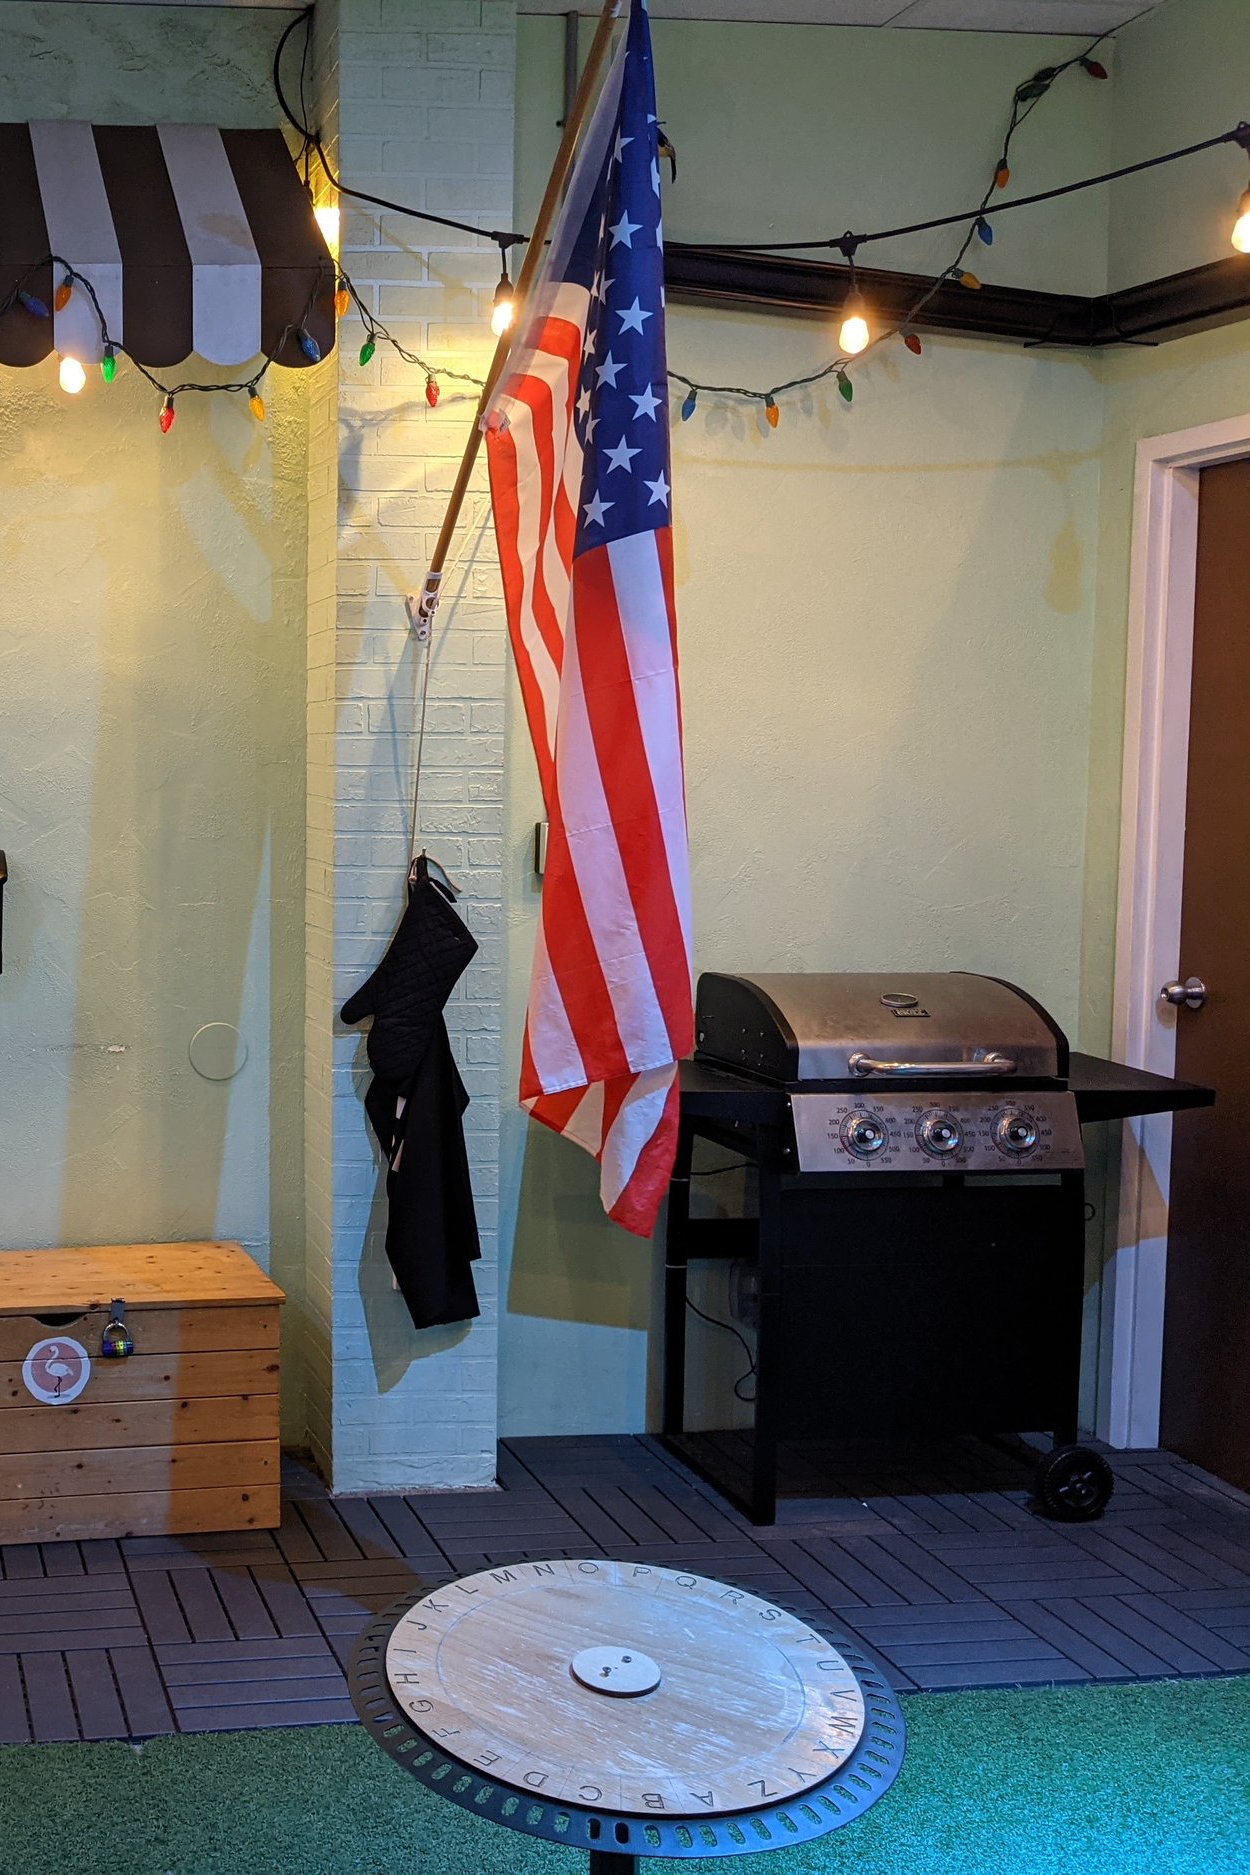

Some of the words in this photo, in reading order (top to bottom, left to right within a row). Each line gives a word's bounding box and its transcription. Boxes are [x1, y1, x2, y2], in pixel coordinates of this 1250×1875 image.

[533, 1563, 555, 1577] N
[578, 1562, 599, 1574] O
[633, 1566, 652, 1577] P
[489, 1569, 517, 1584] M
[675, 1575, 697, 1589] Q
[455, 1585, 478, 1594] L
[719, 1590, 745, 1605] R
[422, 1599, 449, 1613] K
[759, 1609, 782, 1621] S
[406, 1620, 427, 1630] J
[796, 1633, 821, 1643] T
[817, 1660, 844, 1671] U
[394, 1673, 420, 1684] H
[830, 1689, 857, 1702] V
[409, 1700, 433, 1713] G
[828, 1716, 858, 1734] W
[432, 1728, 460, 1738] F
[812, 1741, 845, 1759] X
[473, 1750, 502, 1766] E
[523, 1771, 549, 1787] D
[788, 1767, 817, 1783] Y
[578, 1785, 603, 1801] C
[747, 1780, 778, 1797] Z
[641, 1793, 665, 1809] B
[689, 1791, 714, 1807] A
